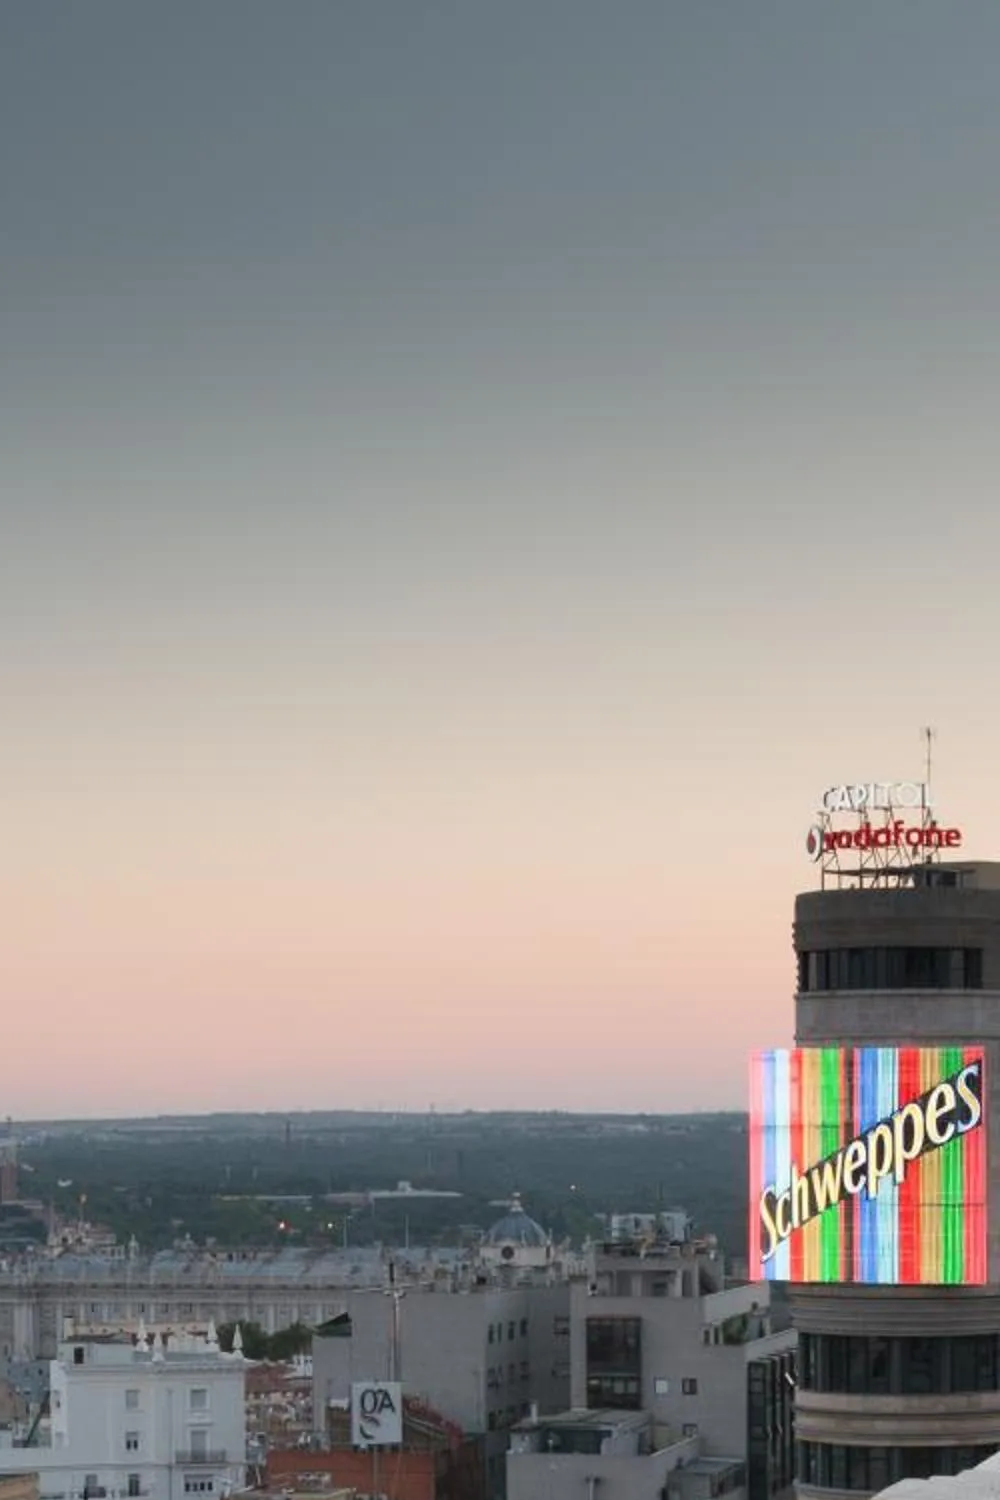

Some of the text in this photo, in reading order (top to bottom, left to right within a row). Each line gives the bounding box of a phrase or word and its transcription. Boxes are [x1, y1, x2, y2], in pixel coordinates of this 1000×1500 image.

[823, 782, 936, 812] CAPITOL
[823, 819, 962, 850] vodafone
[759, 1063, 982, 1265] Schweppes
